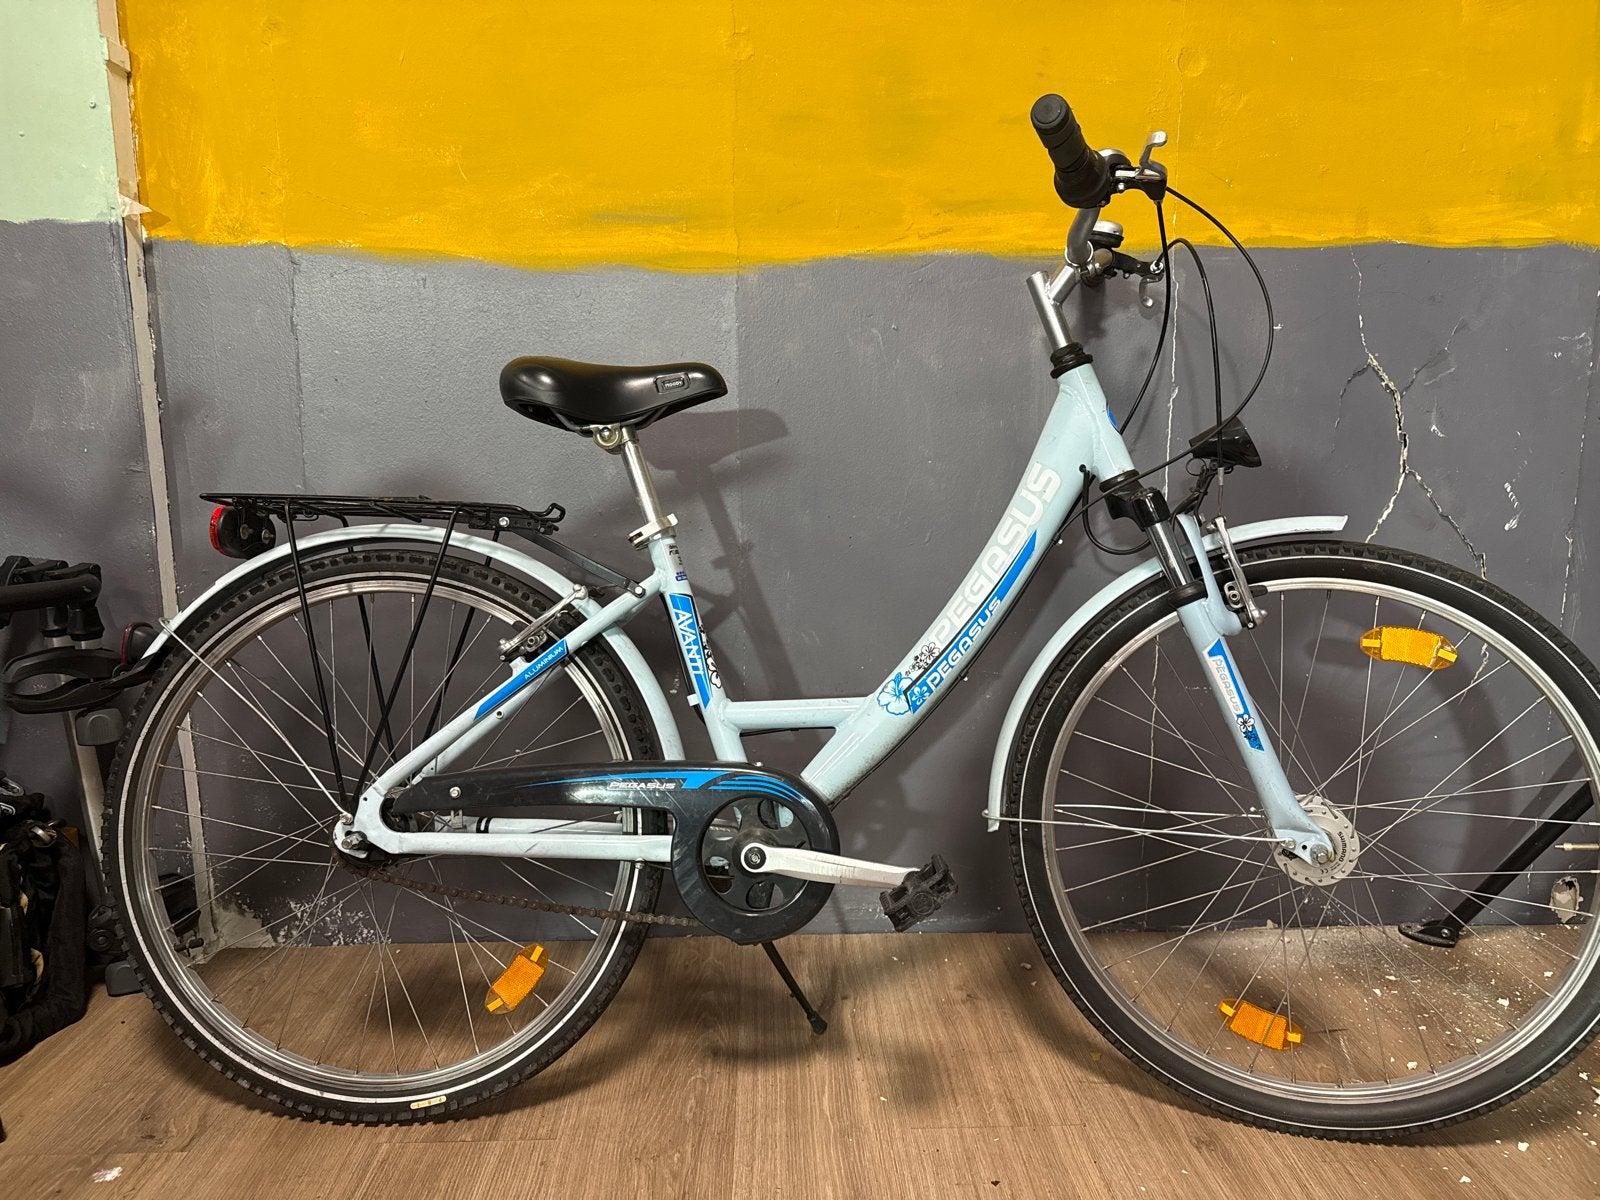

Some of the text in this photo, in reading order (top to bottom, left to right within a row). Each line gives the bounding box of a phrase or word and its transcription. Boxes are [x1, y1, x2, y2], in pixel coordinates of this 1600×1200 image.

[929, 461, 1062, 647] PEGASUS
[524, 646, 563, 680] ALUMINIUM
[672, 608, 704, 675] AVANTI
[926, 596, 1002, 691] PEGASUS
[1213, 658, 1241, 712] PEGASUS
[609, 781, 676, 789] PEGASUS
[1337, 831, 1347, 863] SHIMANO
